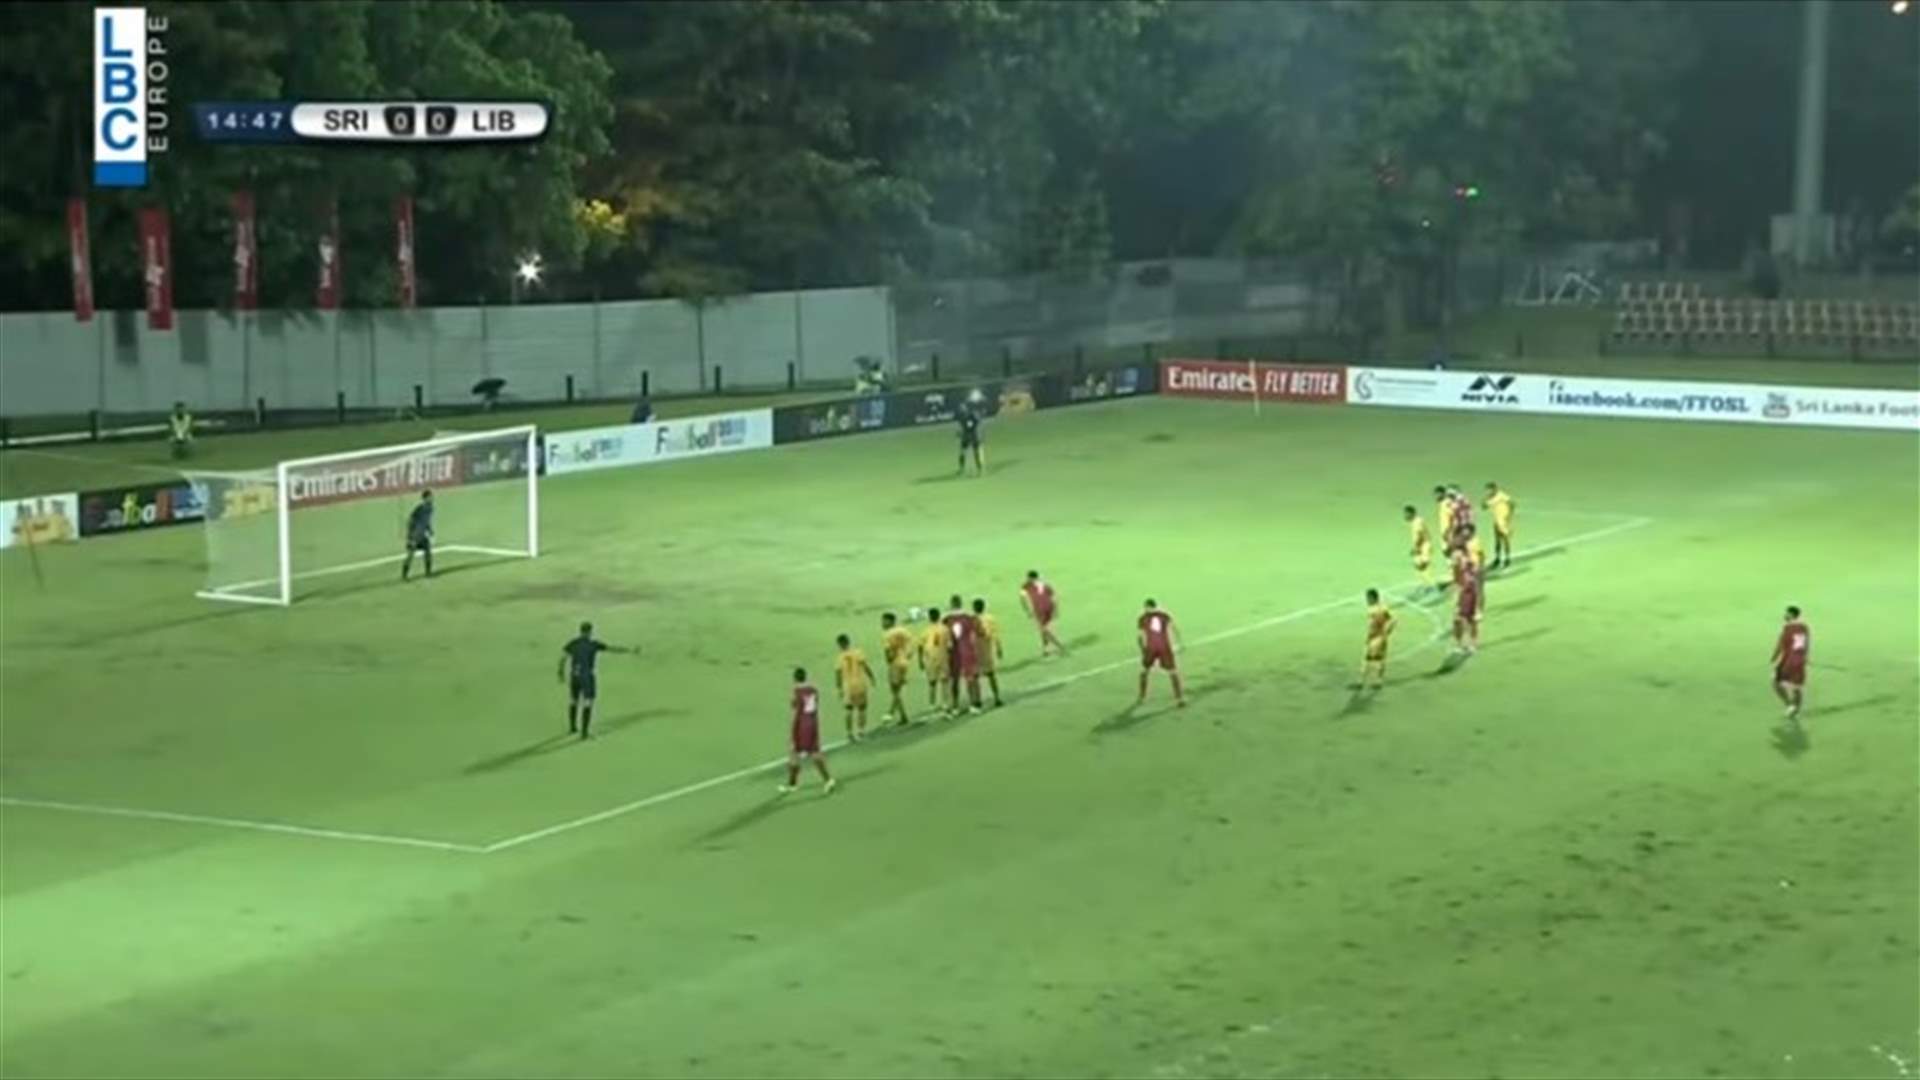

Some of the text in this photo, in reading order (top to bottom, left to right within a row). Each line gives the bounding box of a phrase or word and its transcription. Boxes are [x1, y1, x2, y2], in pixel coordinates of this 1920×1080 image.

[1167, 366, 1339, 395] Emirates FLY BETTER
[1796, 399, 1818, 413] Sri
[1822, 400, 1875, 415] Lanka
[289, 467, 379, 500] Emirates
